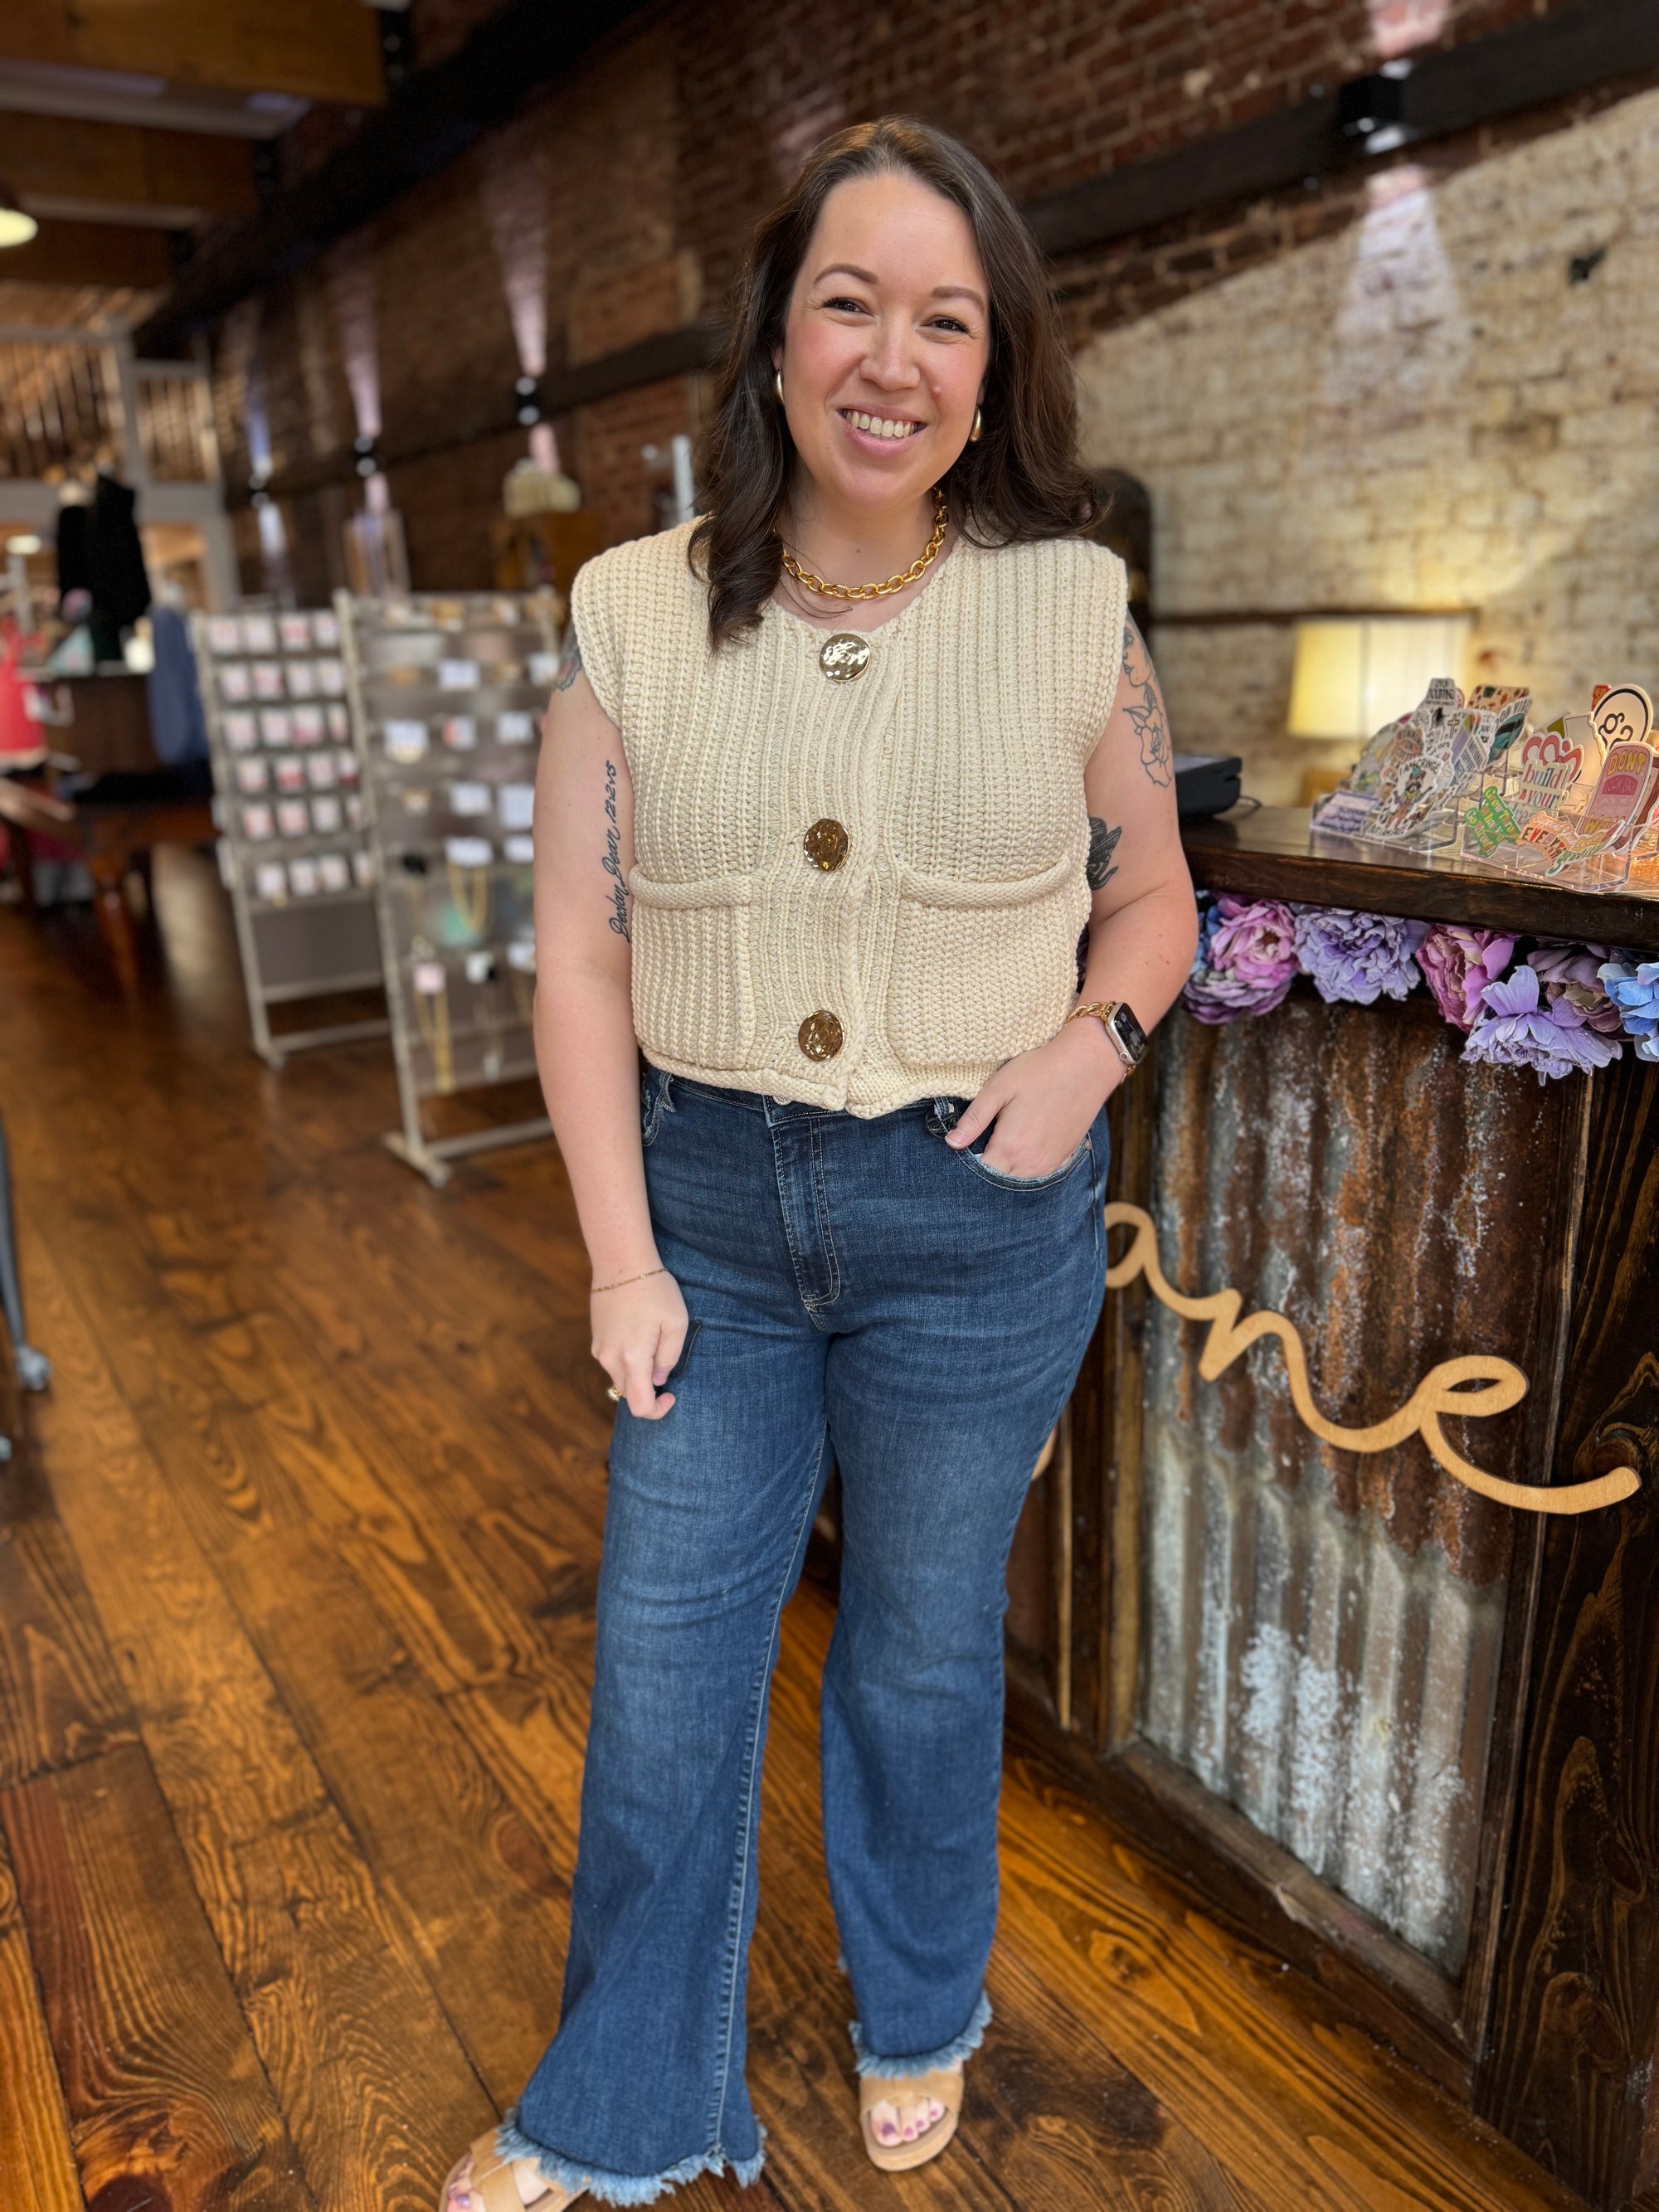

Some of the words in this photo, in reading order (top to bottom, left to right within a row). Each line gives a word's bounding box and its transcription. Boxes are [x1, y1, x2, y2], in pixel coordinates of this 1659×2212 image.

[1523, 764, 1564, 790] build
[1523, 790, 1560, 809] your
[1104, 1201, 1642, 1514] ane
